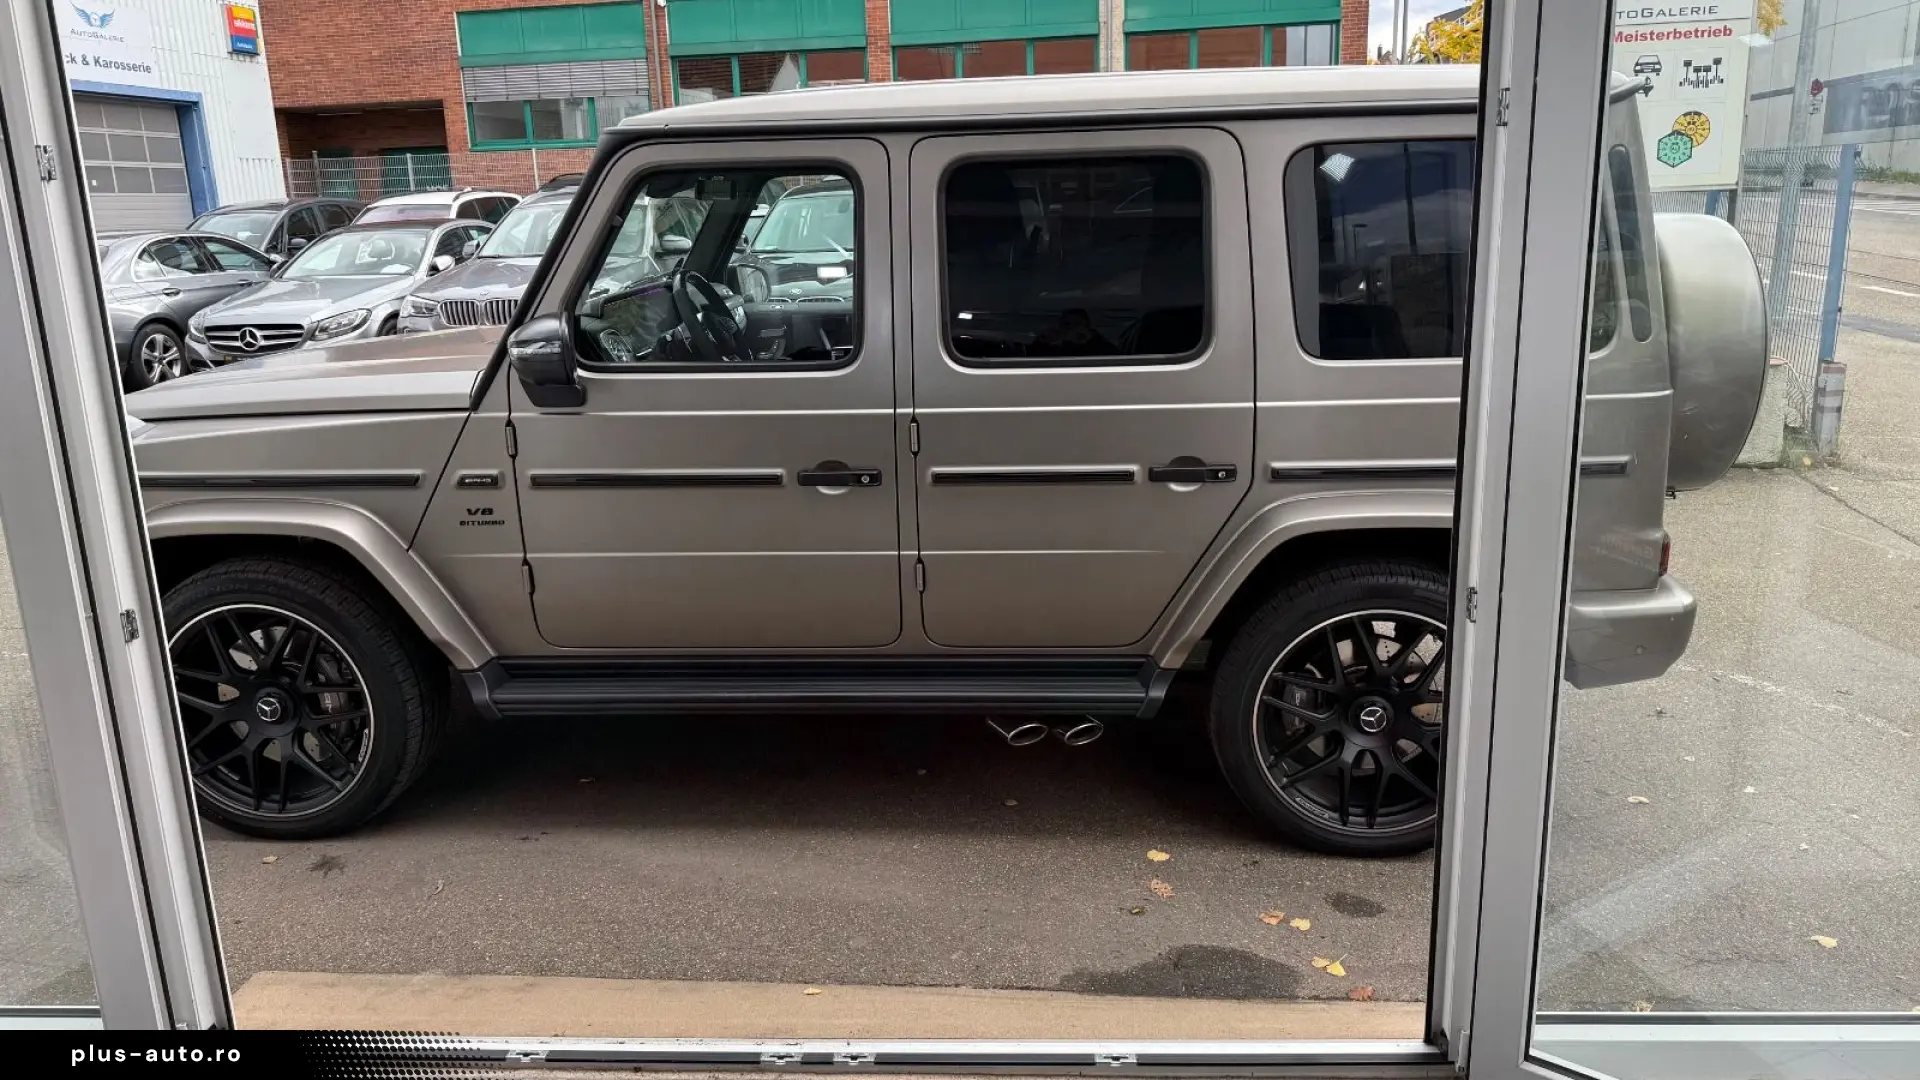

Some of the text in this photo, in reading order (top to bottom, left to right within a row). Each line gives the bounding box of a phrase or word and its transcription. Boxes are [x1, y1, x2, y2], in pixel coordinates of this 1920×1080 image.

[81, 54, 90, 66] &
[93, 55, 152, 74] Karosserie
[466, 507, 494, 516] V8
